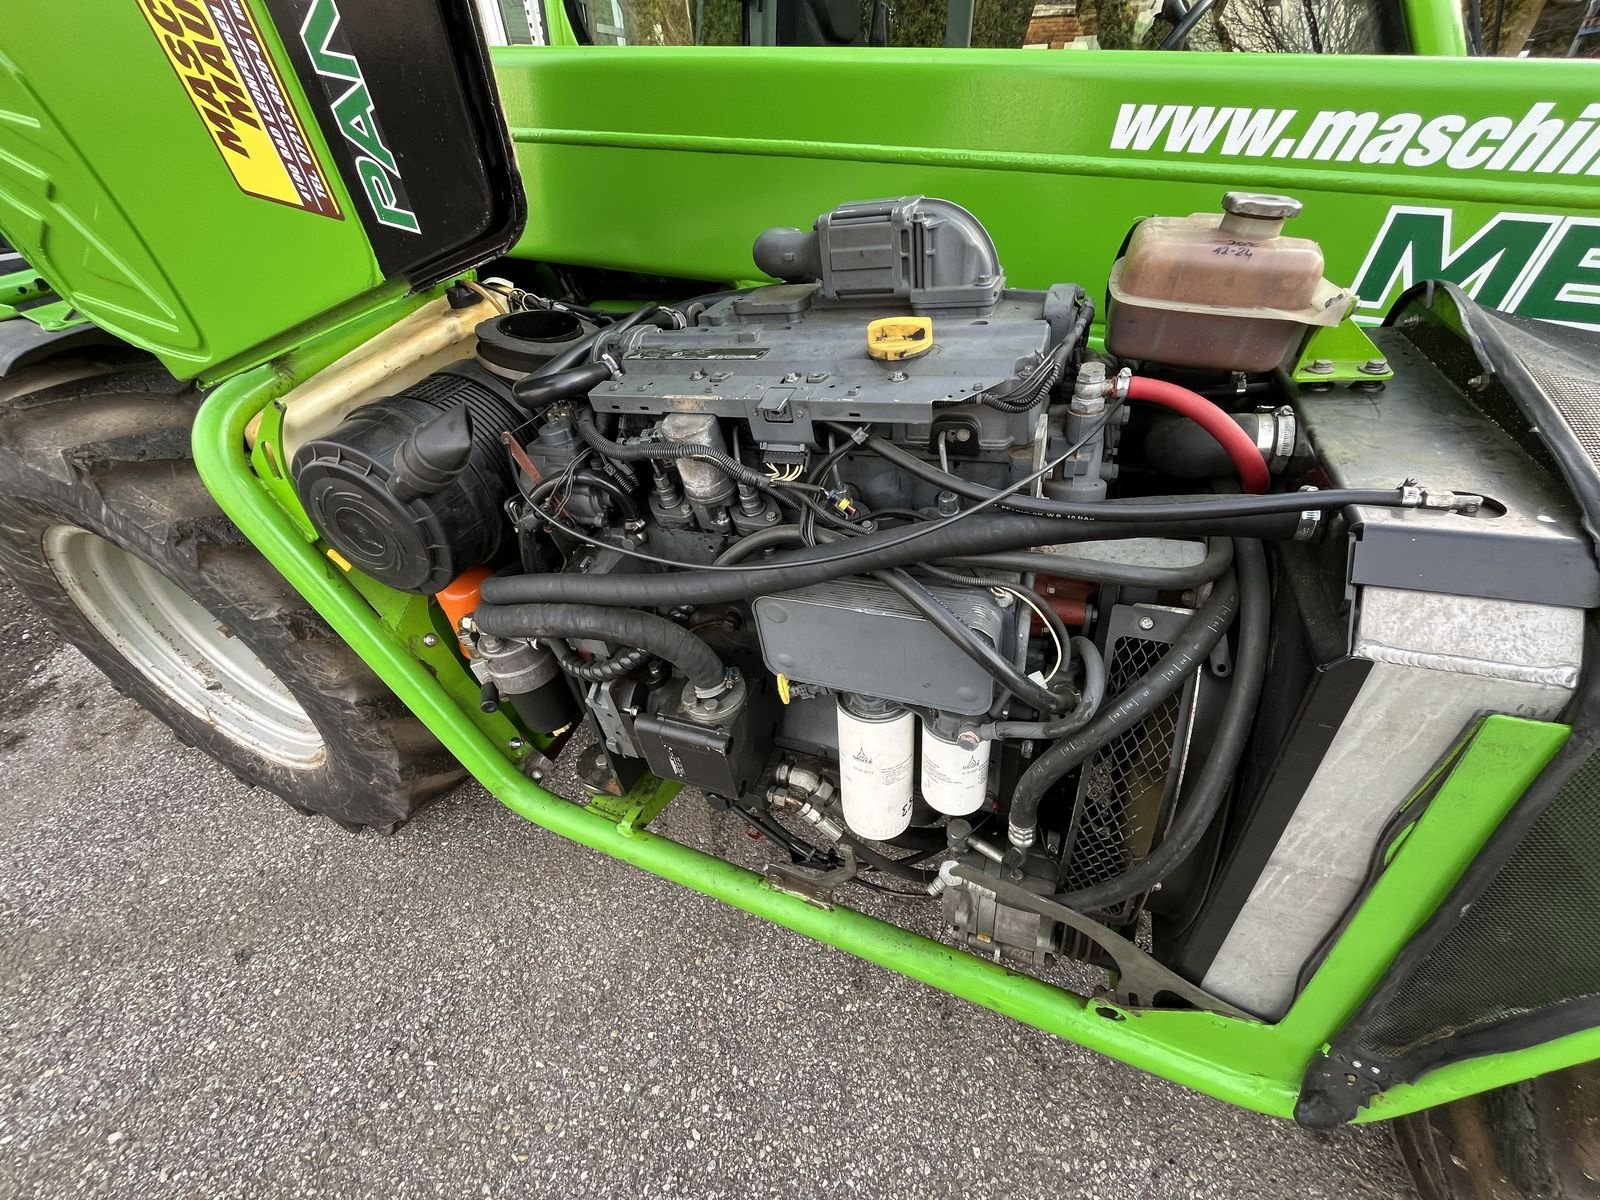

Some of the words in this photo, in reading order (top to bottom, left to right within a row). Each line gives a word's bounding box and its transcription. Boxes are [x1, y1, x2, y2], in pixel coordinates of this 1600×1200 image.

[143, 0, 250, 159] MASC
[172, 0, 262, 131] MAU
[210, 4, 276, 124] LEONFELDEN
[246, 38, 312, 165] 07213-6820-0
[269, 126, 293, 162] BAD
[288, 163, 312, 202] 4190
[308, 170, 328, 198] TEL.
